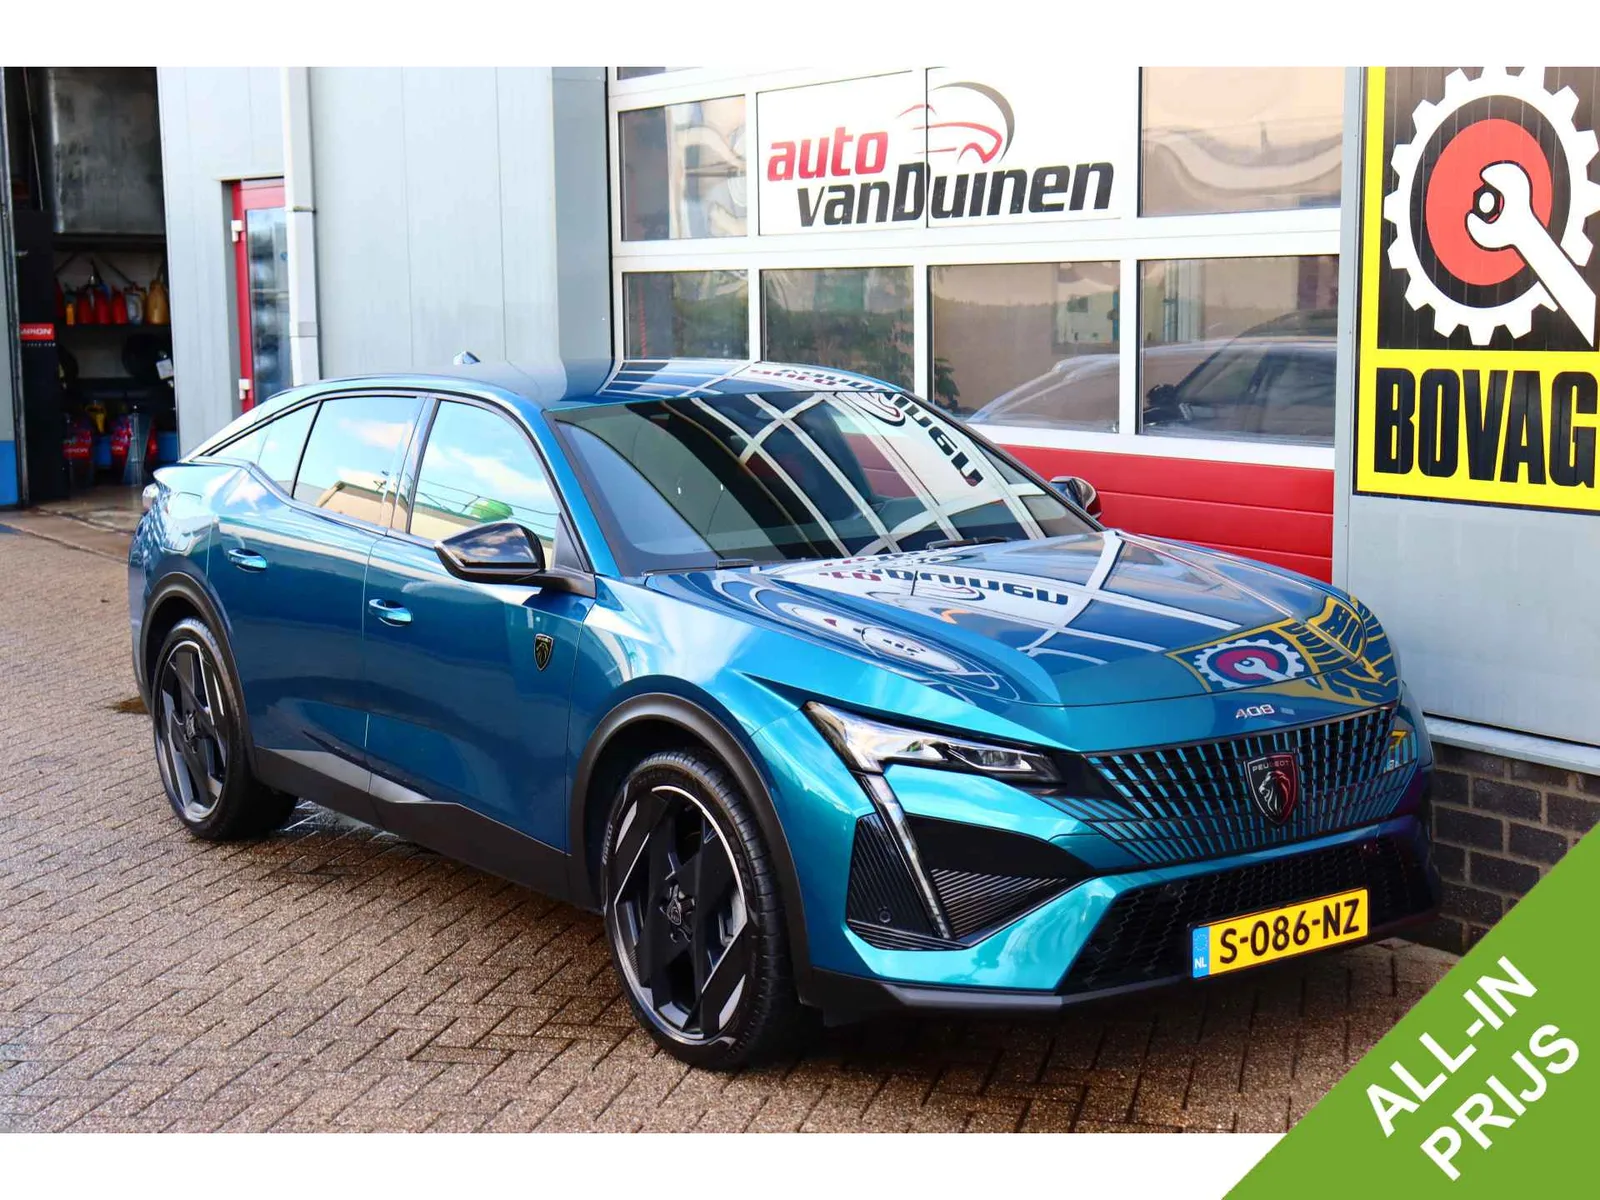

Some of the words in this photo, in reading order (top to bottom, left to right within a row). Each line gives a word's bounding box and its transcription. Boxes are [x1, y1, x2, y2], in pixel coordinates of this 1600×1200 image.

[767, 126, 888, 182] auto
[797, 160, 1114, 228] vanDuinen
[1373, 367, 1599, 489] BOVAG
[1235, 703, 1275, 719] 408
[1219, 898, 1360, 964] S-086-NZ
[1194, 956, 1207, 969] NL
